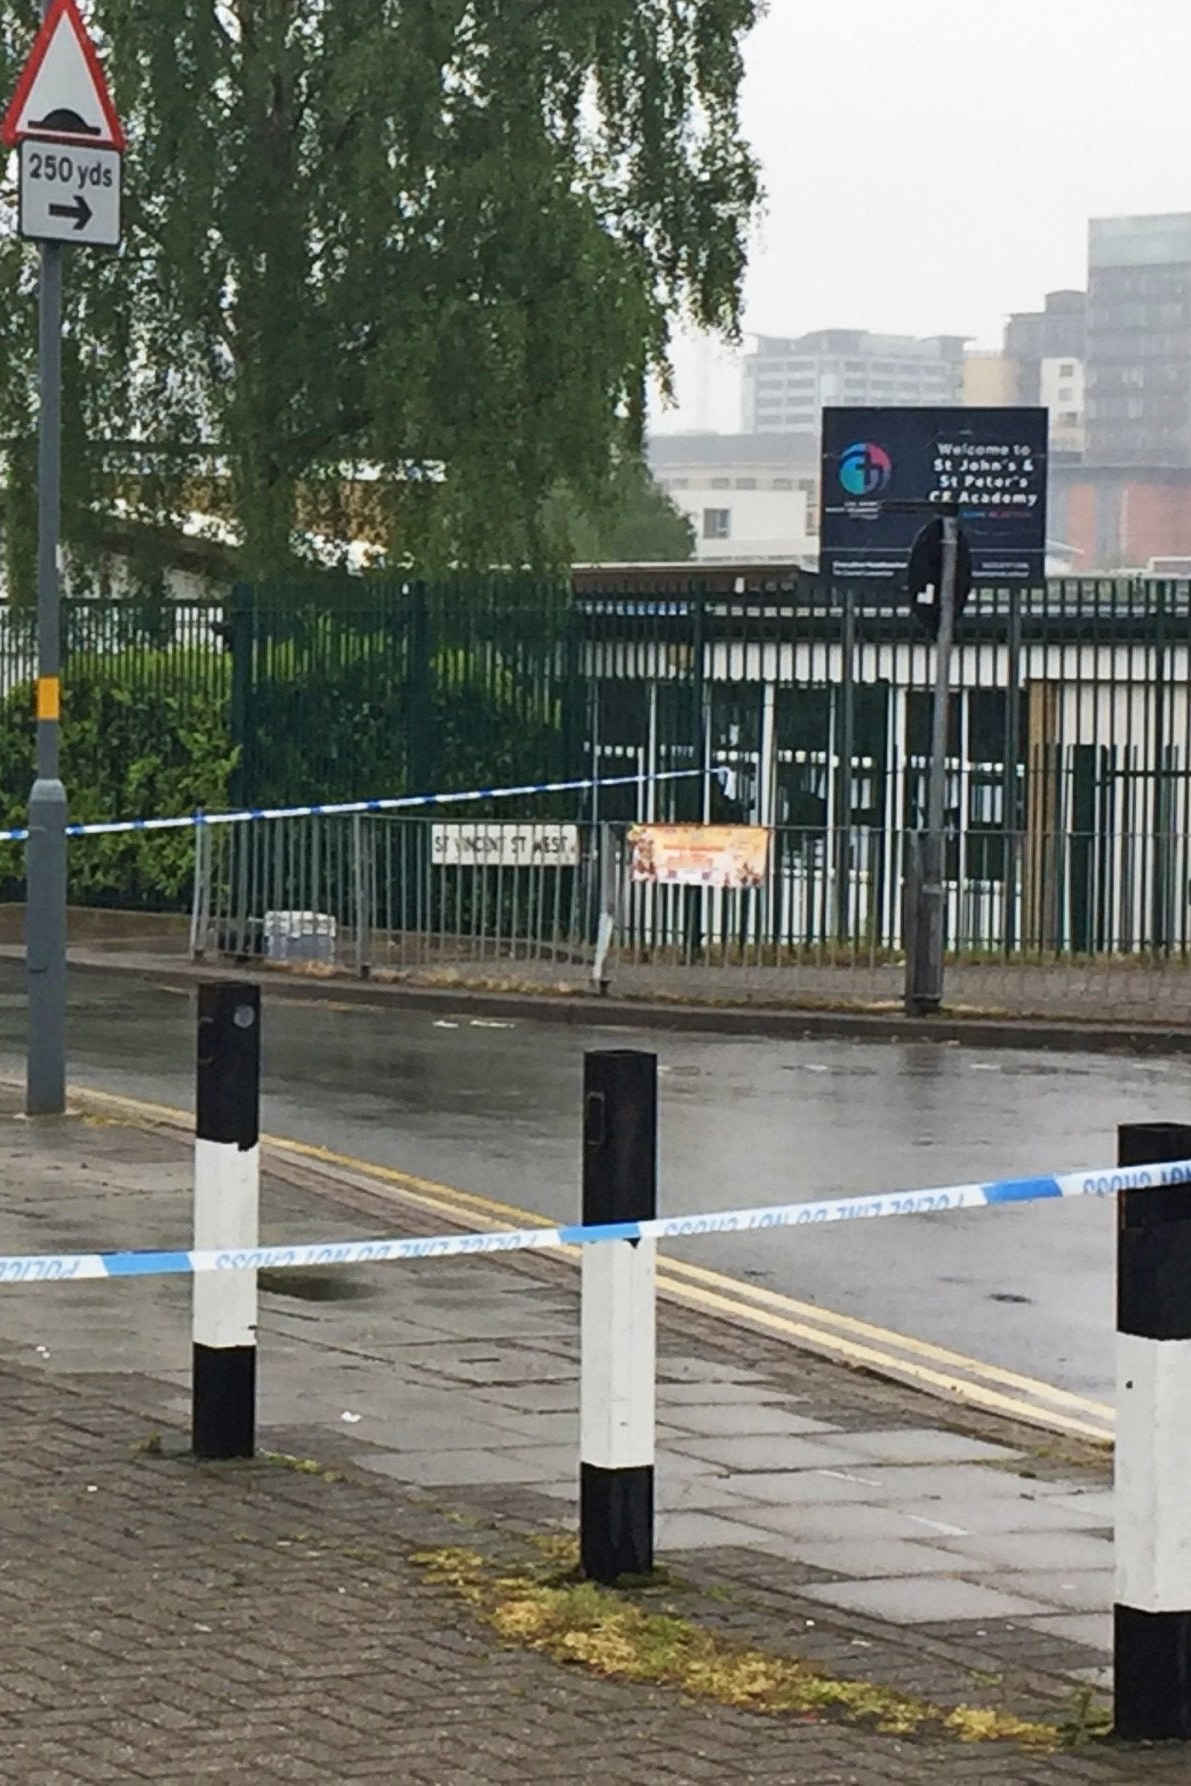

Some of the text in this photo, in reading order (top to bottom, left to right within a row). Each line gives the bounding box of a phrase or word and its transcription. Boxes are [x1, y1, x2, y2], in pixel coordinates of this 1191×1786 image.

[29, 153, 112, 189] 250 yds
[937, 443, 1030, 456] Welcome to
[934, 458, 952, 472] St
[959, 458, 1016, 472] John's
[939, 475, 1028, 488] St Peter's
[958, 490, 1037, 507] Academy
[511, 836, 526, 853] ST
